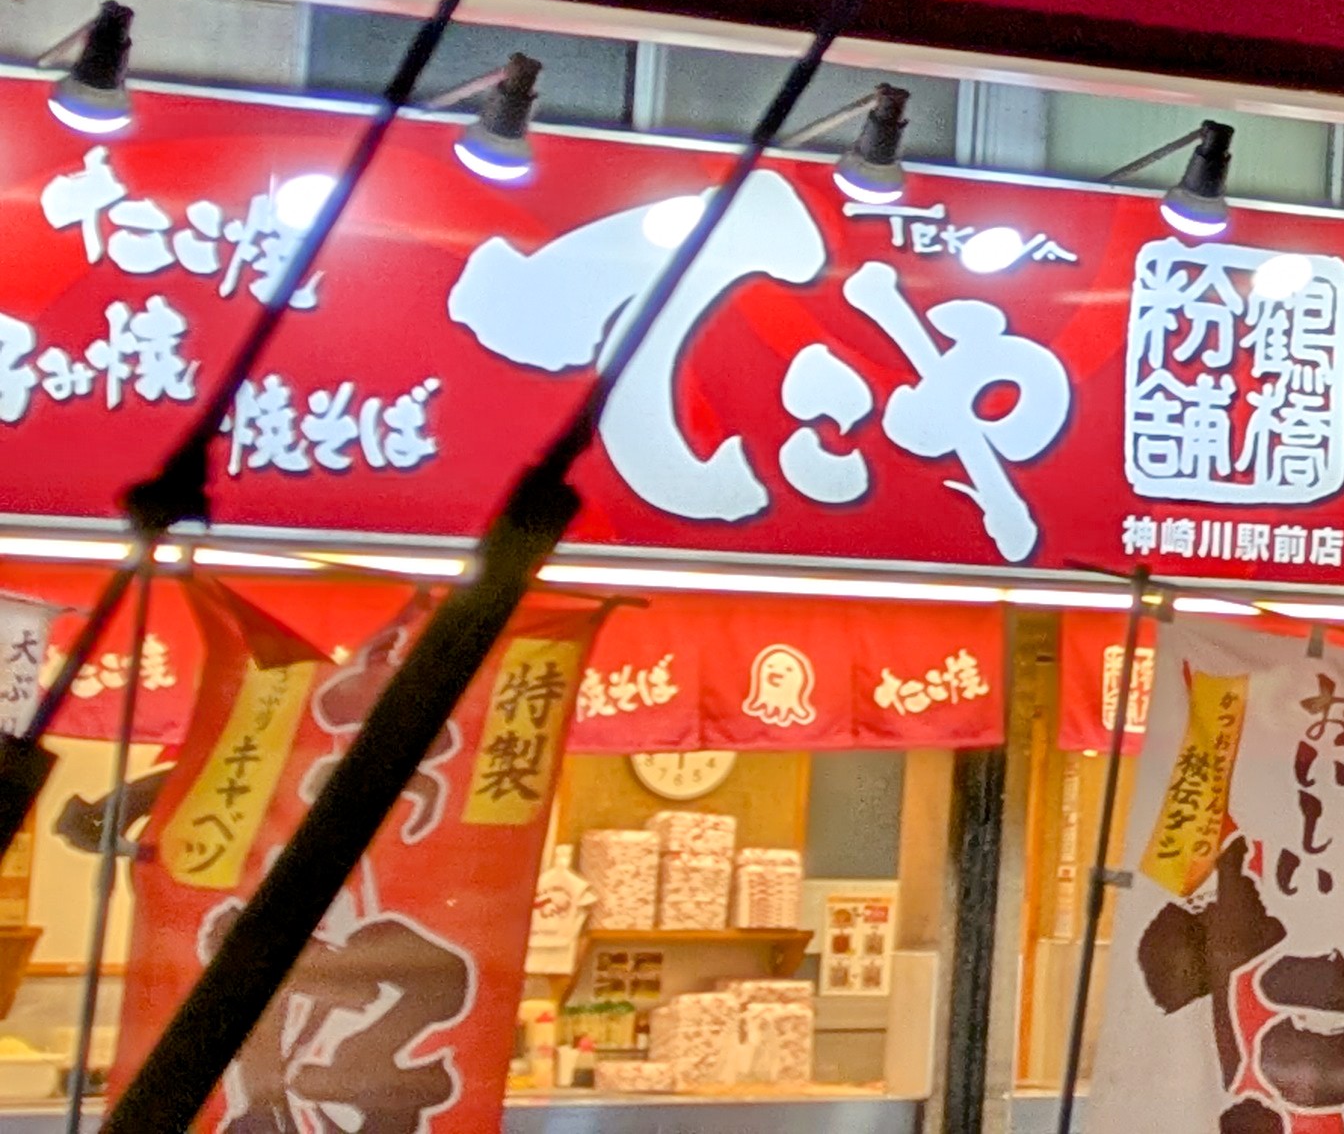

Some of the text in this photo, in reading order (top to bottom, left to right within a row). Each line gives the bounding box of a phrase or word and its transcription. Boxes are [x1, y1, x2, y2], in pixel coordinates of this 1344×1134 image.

[220, 375, 440, 476] 焼そば
[1121, 514, 1344, 567] 神崎川駅前店
[873, 648, 989, 716] たこ焼
[474, 659, 570, 804] 特製
